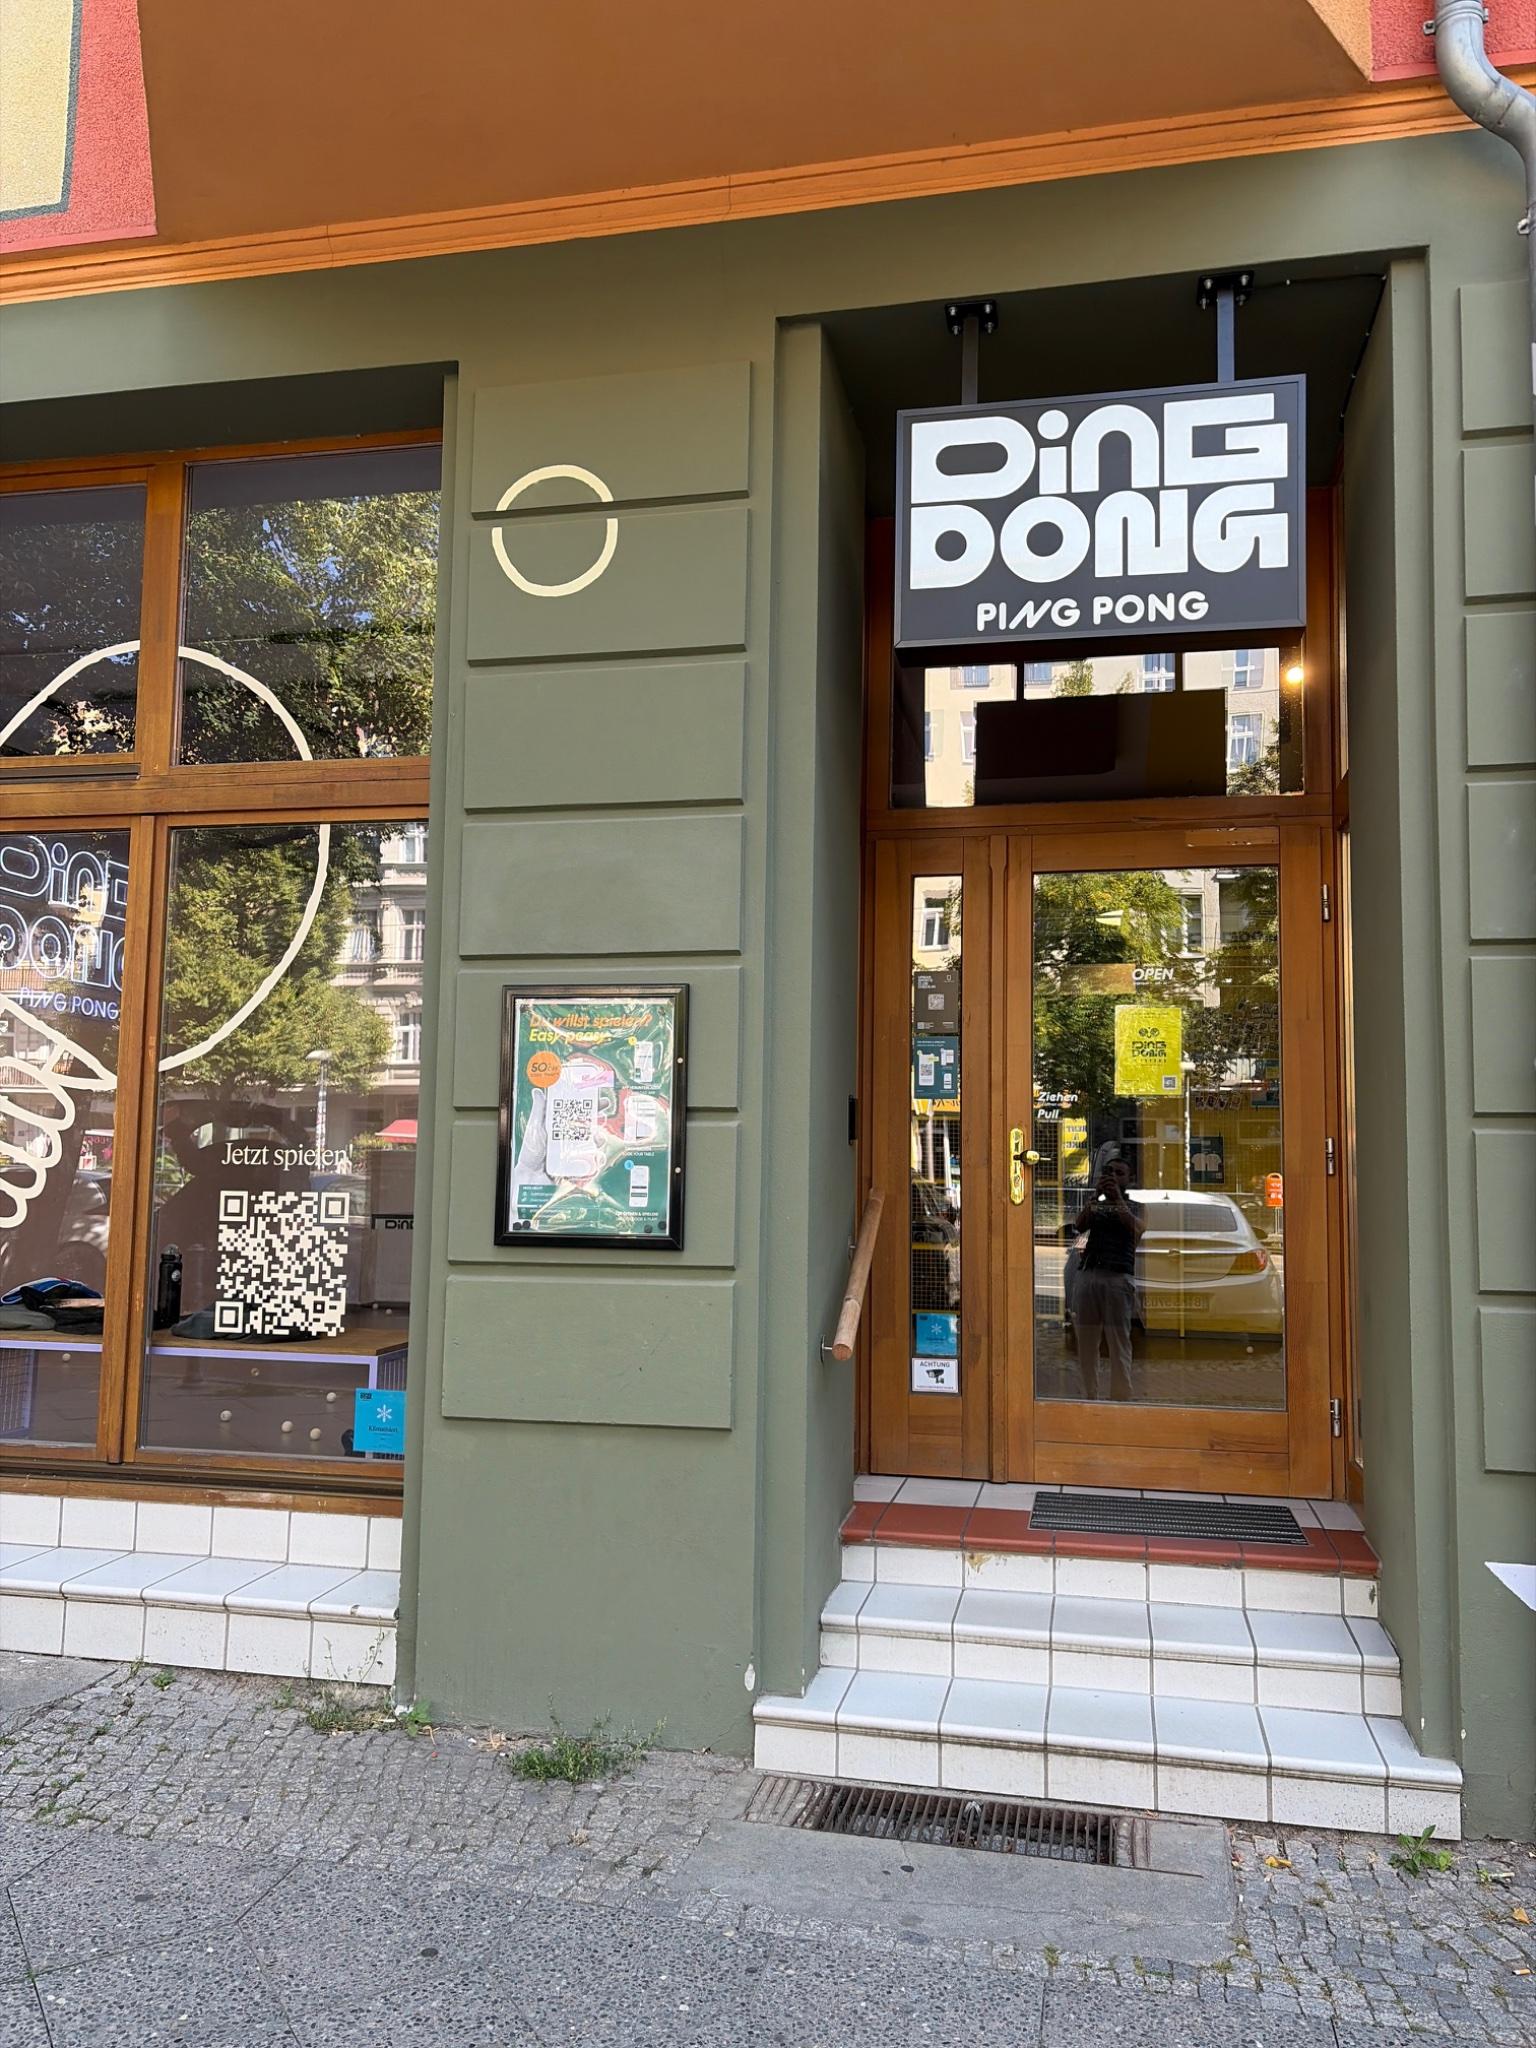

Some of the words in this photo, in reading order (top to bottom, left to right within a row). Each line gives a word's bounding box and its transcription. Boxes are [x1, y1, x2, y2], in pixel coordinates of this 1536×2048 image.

[910, 482, 1289, 589] DONG
[976, 596, 1080, 631] PING
[1093, 591, 1209, 625] PONG
[1132, 968, 1174, 981] OPEN
[19, 988, 67, 1011] PING
[71, 995, 119, 1020] PONG
[553, 1013, 590, 1027] willst
[1037, 1091, 1079, 1102] Ziehen
[1037, 1109, 1060, 1119] Pull
[221, 1142, 270, 1166] Jetzt
